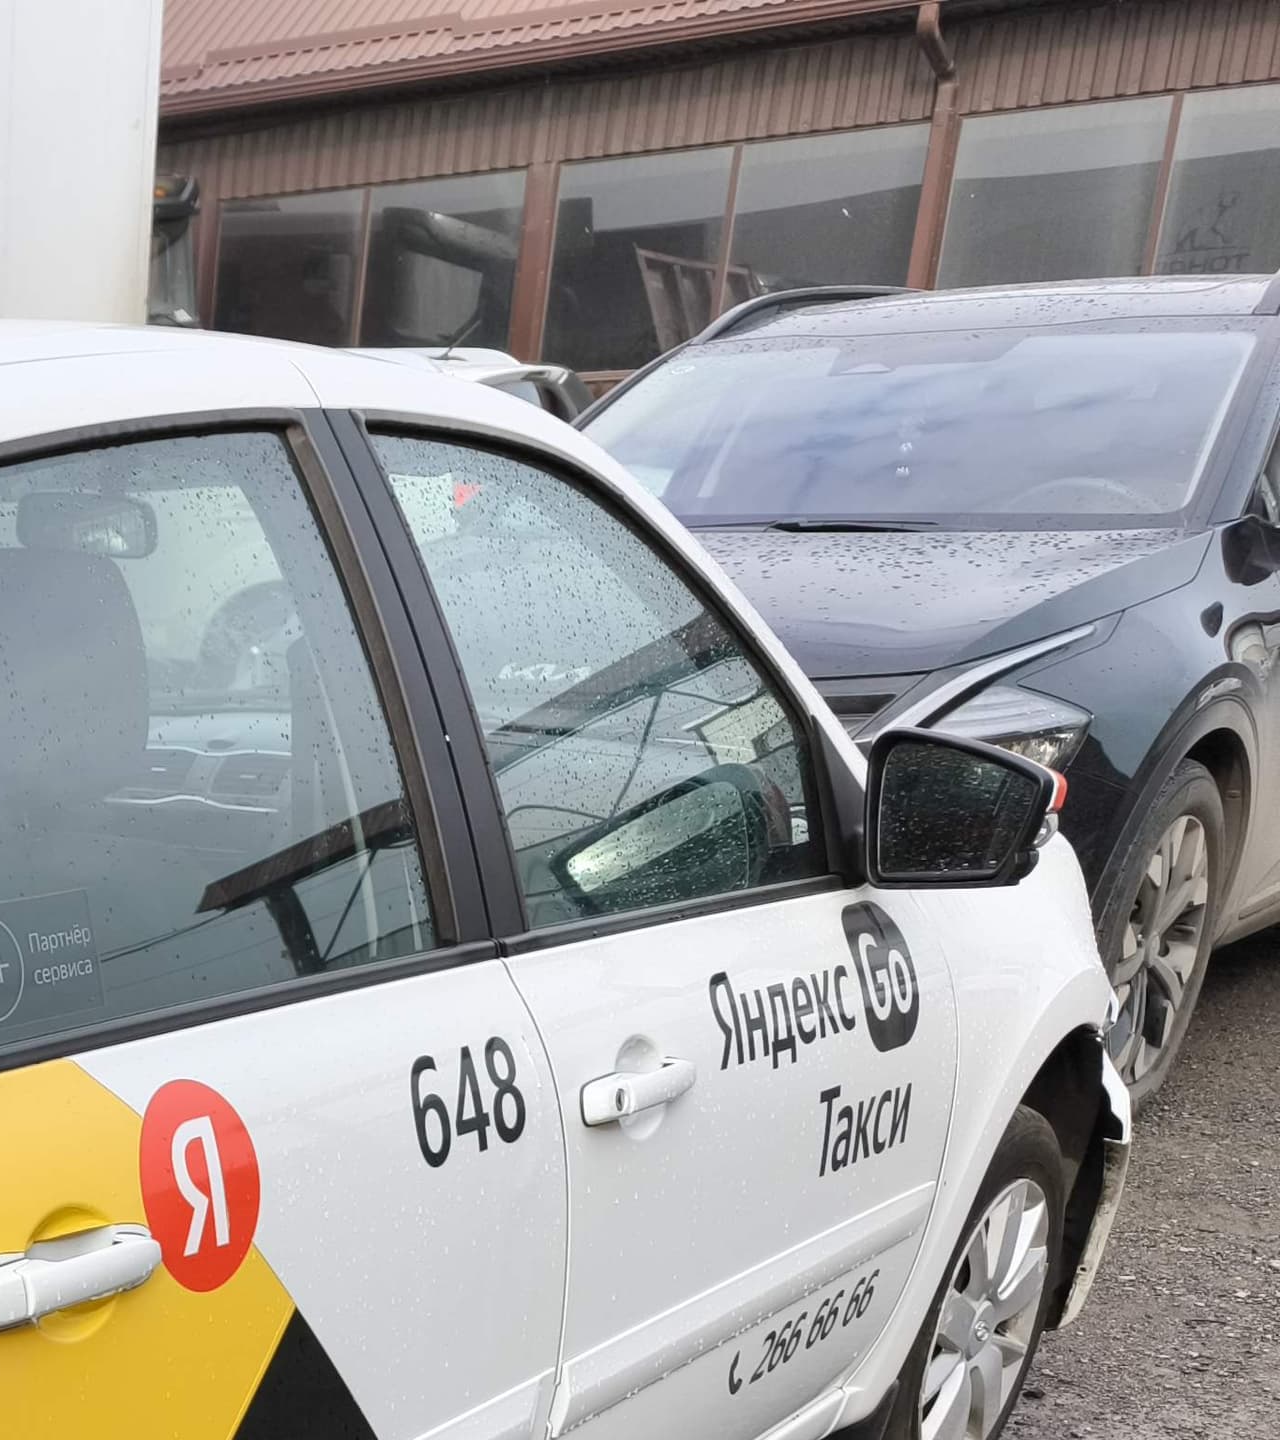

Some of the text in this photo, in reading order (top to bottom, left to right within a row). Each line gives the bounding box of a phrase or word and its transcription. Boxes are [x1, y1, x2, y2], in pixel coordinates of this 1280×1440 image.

[28, 924, 92, 955] Партнёр
[34, 959, 93, 986] сервиса
[707, 931, 915, 1070] Яндекс Go
[410, 1036, 527, 1168] 648
[818, 1083, 913, 1178] Такси
[171, 1115, 230, 1257] Я
[749, 1268, 880, 1385] 266 66 66
